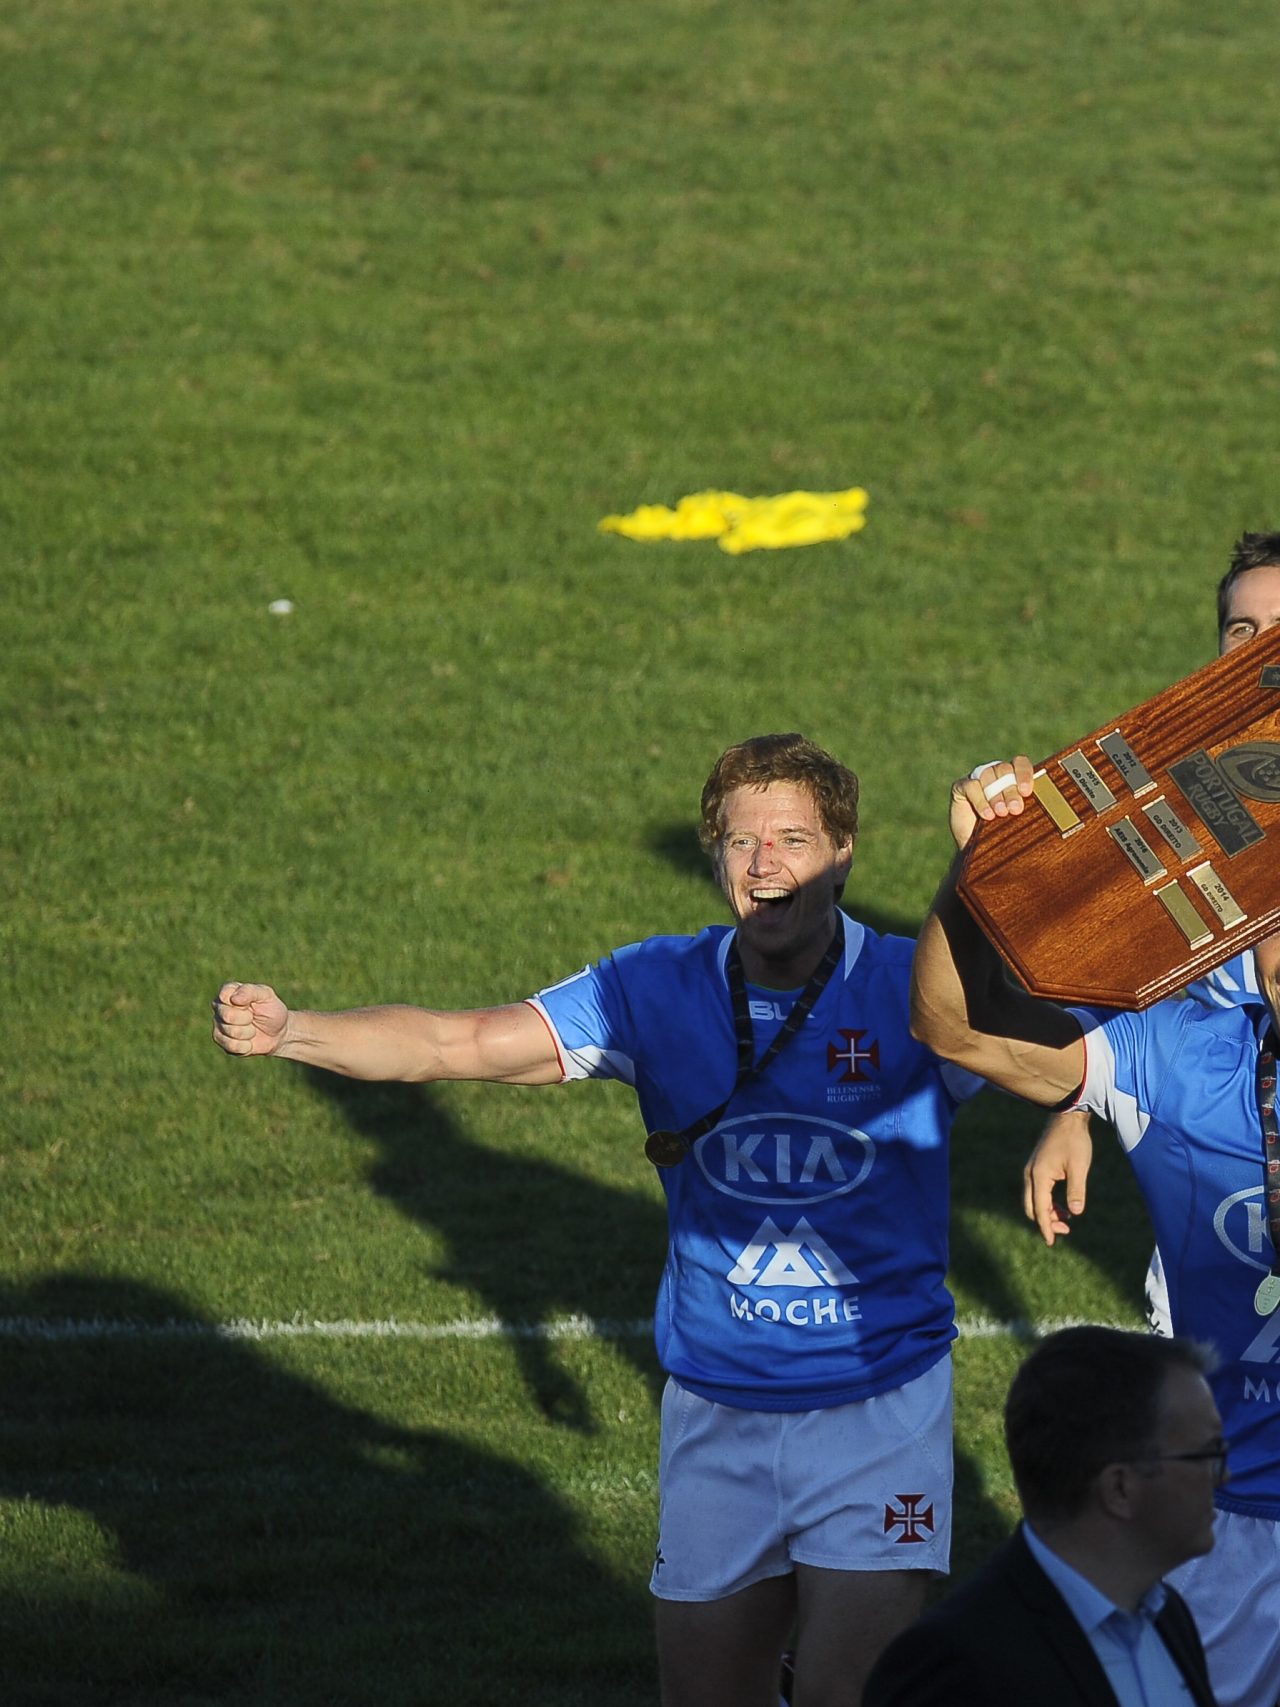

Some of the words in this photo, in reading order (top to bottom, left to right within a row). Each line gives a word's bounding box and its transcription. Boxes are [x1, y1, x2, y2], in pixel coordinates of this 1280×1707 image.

[1072, 768, 1082, 779] GD
[1187, 754, 1259, 845] PORTUGAL
[1188, 783, 1229, 826] RUGBY
[1153, 814, 1163, 825] GD
[1214, 883, 1229, 901] 2014
[721, 1133, 849, 1184] KIA
[730, 1293, 863, 1327] MOCHE
